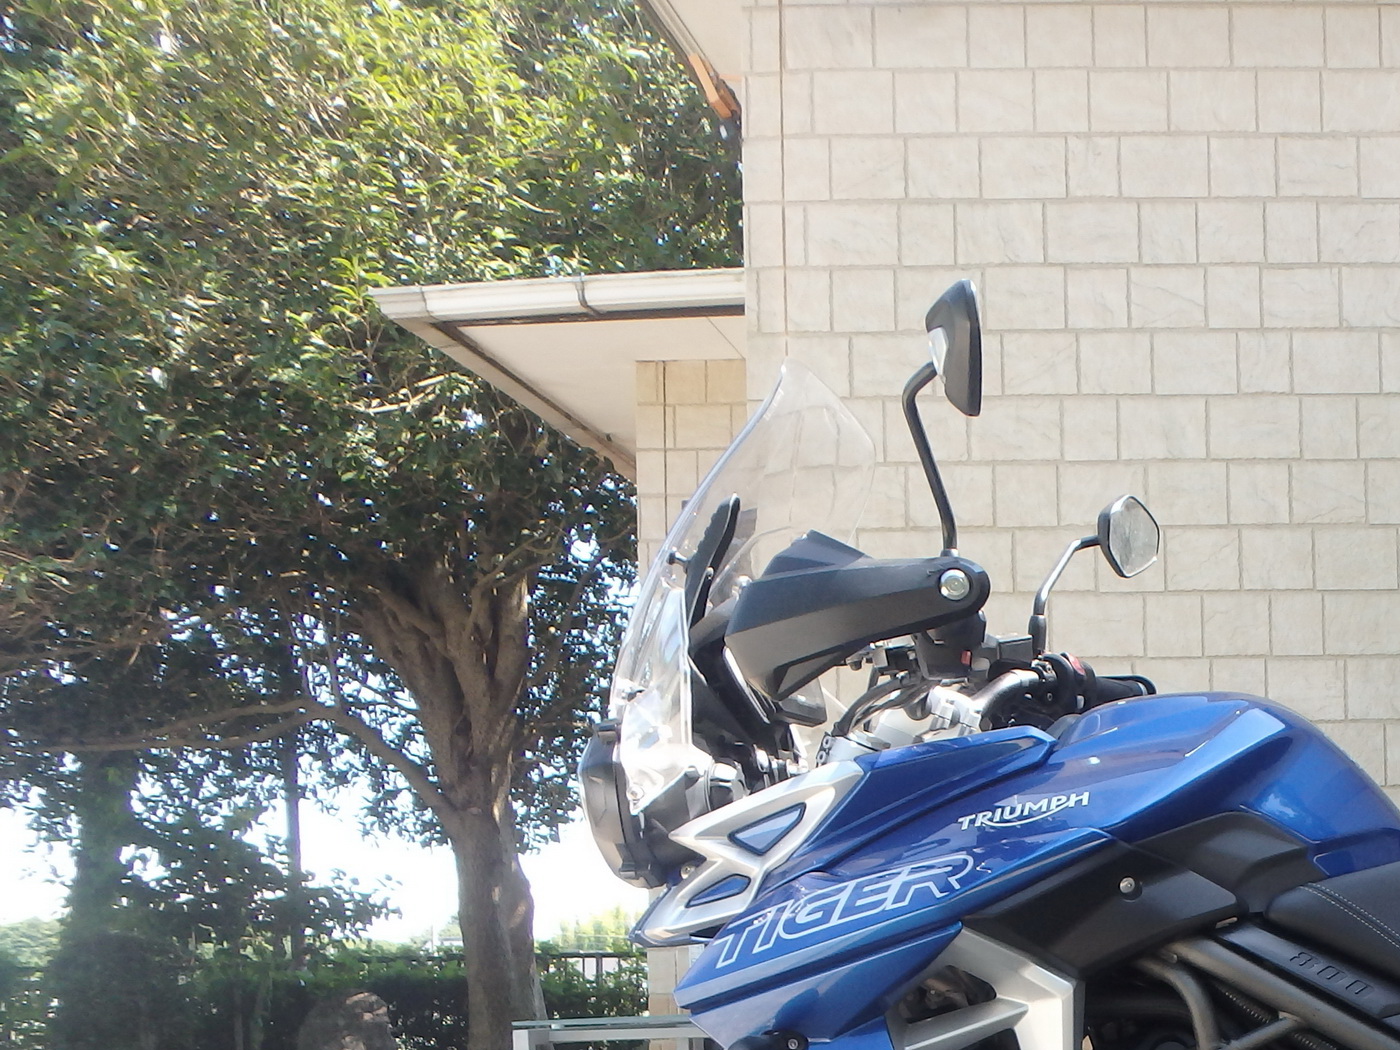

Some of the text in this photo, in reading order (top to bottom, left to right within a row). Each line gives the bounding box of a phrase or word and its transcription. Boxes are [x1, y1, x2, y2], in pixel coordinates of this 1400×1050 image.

[957, 791, 1090, 831] TRIUMPH
[713, 853, 975, 969] TIGER
[1289, 951, 1376, 999] 800
